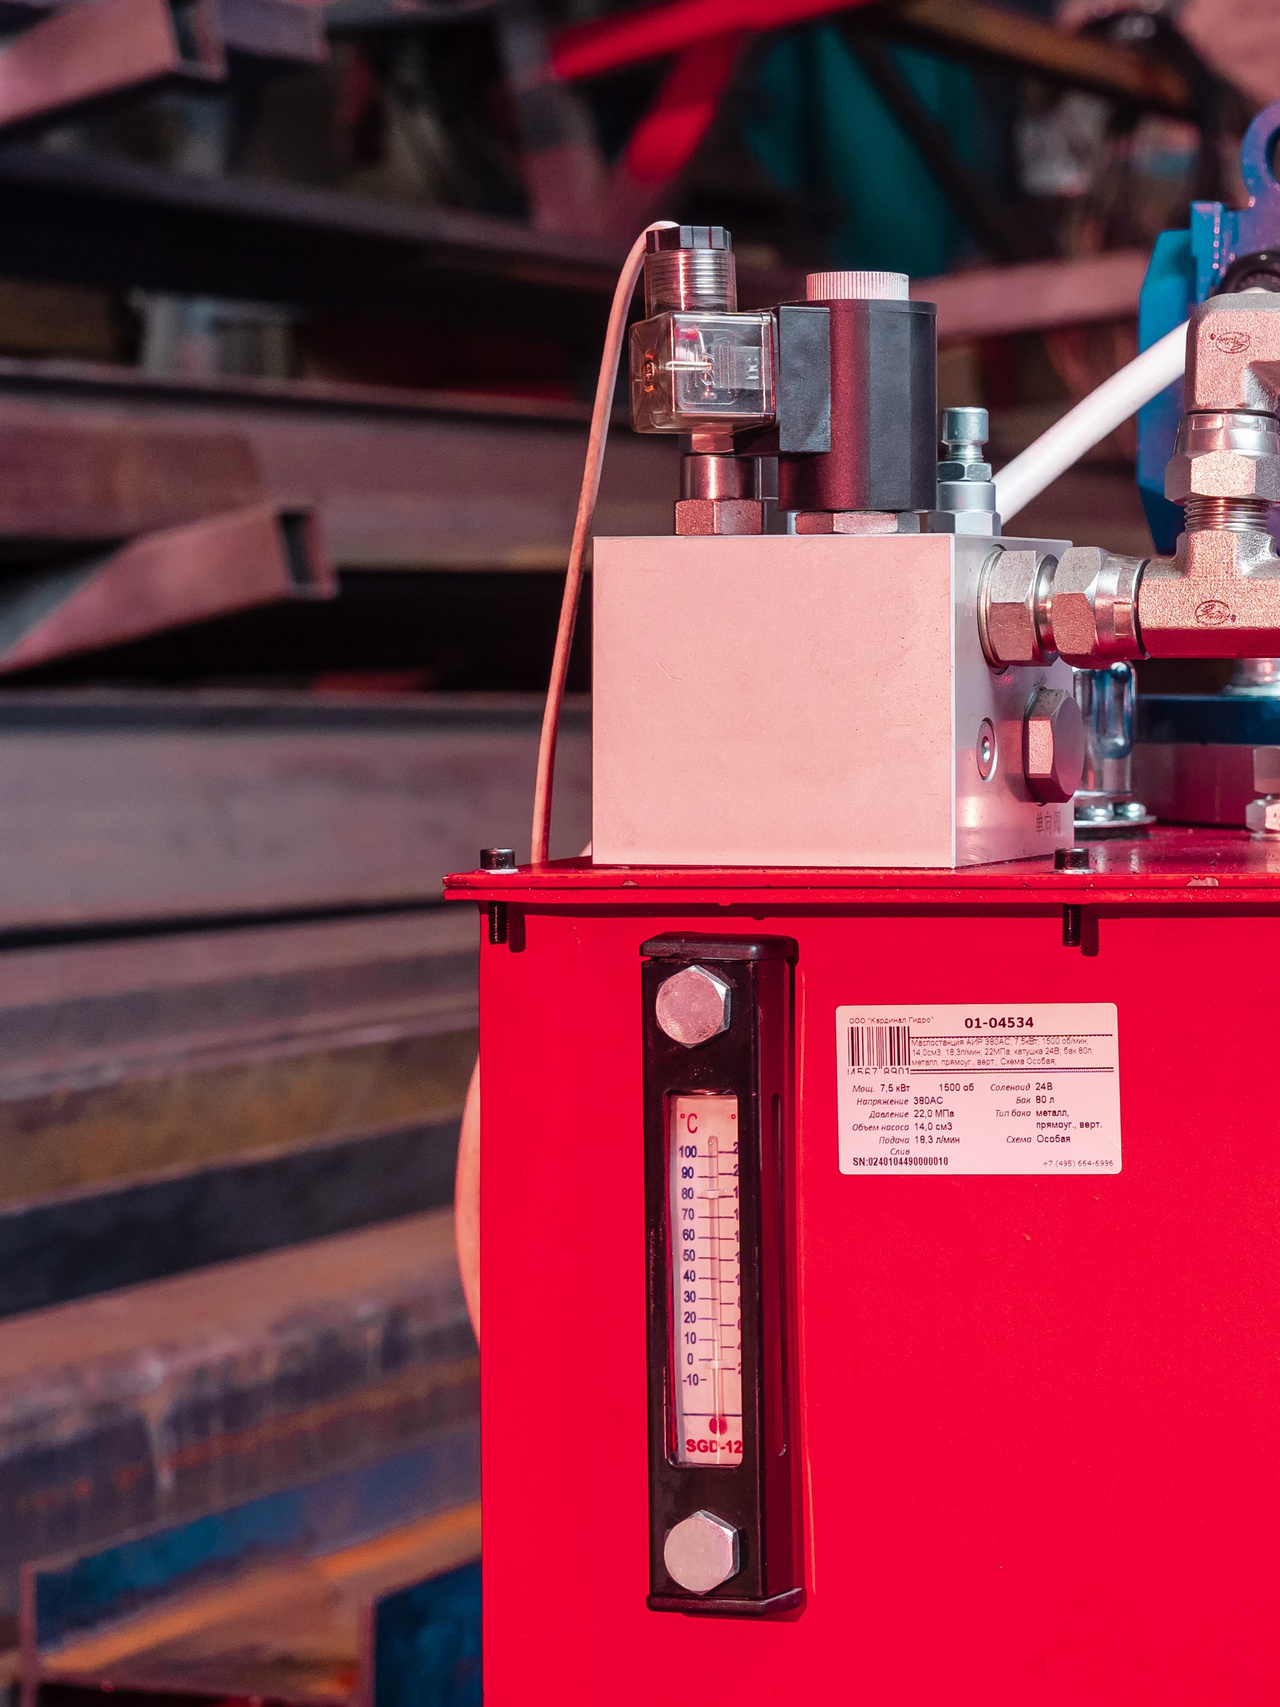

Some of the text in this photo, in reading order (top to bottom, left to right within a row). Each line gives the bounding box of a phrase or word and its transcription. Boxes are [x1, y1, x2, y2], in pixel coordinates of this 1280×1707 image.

[964, 1017, 1034, 1028] 01-04534
[1000, 1057, 1025, 1065] Схема
[852, 1083, 974, 1094] Мощ. 7,5 кВт 1500 об
[990, 1082, 1053, 1091] Соленоид 24В
[856, 1098, 909, 1106] Напряжение
[1016, 1096, 1031, 1104] Бак
[1035, 1095, 1046, 1103] 80
[868, 1109, 955, 1119] Давление 22,0 МПа
[995, 1109, 1070, 1118] Тип бака металл,
[680, 1113, 698, 1134] °C
[852, 1123, 879, 1131] Объем
[914, 1122, 933, 1132] 14,0
[935, 1122, 953, 1130] см3
[1079, 1121, 1103, 1130] верт.
[878, 1135, 960, 1145] Подача 18,3 л/мин
[1006, 1134, 1071, 1143] Схема Особая
[678, 1145, 697, 1158] 100
[853, 1157, 948, 1166] SN:0240104490000010
[681, 1166, 694, 1179] 90
[681, 1187, 694, 1200] 80
[682, 1208, 694, 1220] 70
[682, 1228, 695, 1241] 60
[683, 1249, 696, 1261] 50
[683, 1270, 696, 1282] 40
[684, 1290, 696, 1303] 30
[684, 1311, 696, 1324] 20
[684, 1332, 697, 1344] 10
[687, 1353, 694, 1365] 0
[682, 1373, 699, 1386] -10
